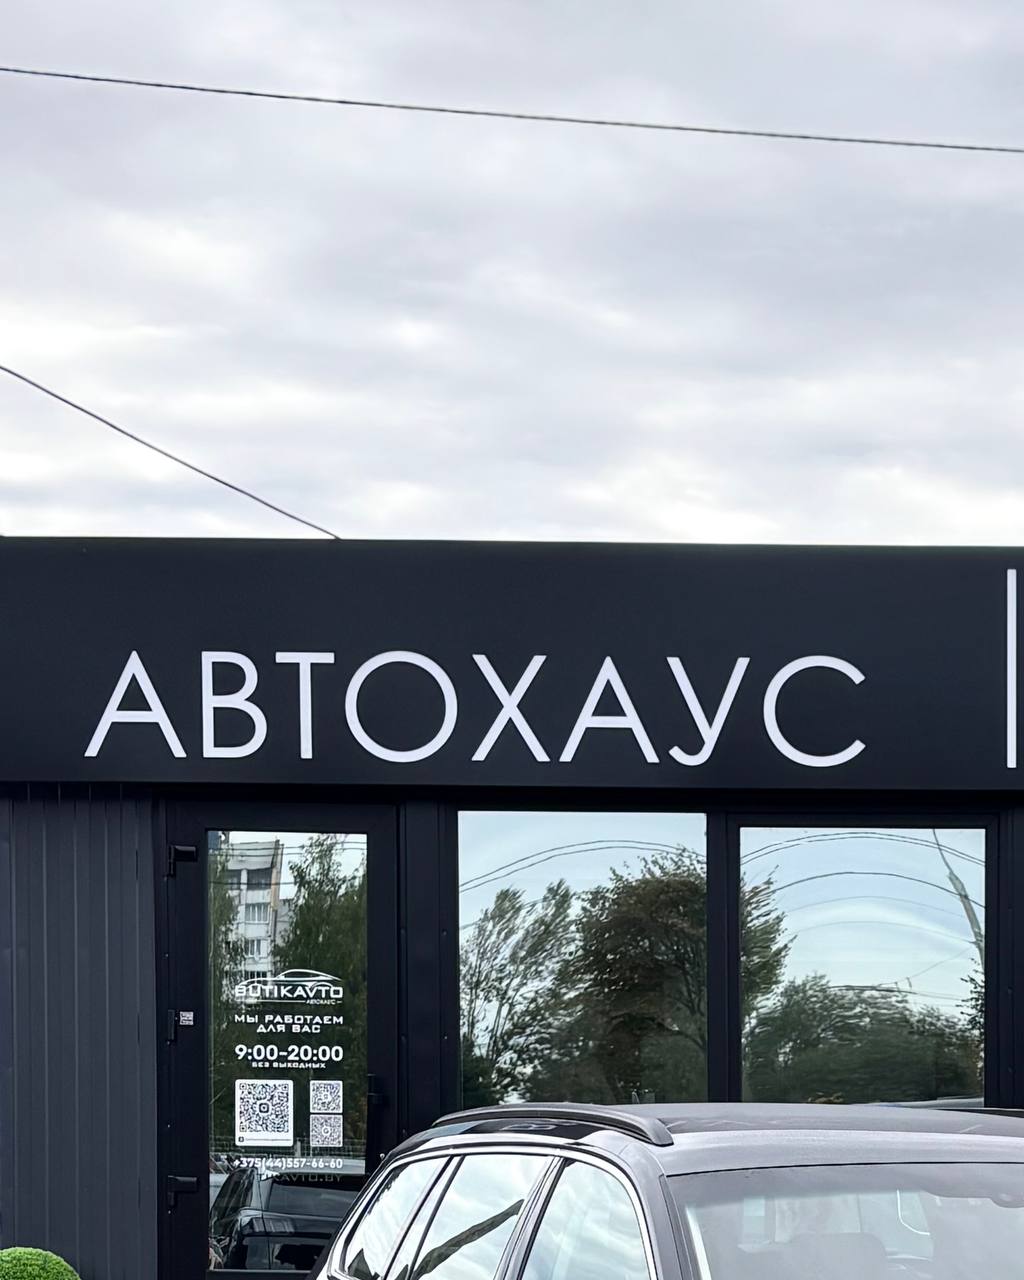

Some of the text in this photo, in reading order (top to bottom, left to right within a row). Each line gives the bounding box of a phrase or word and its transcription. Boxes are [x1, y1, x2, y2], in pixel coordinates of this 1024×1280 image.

[85, 650, 867, 768] АВТОХАУС
[234, 984, 343, 999] BUTIKAVTO
[234, 1014, 343, 1024] МЫ РАБОТАЕМ
[256, 1024, 320, 1034] ДЛЯ ВАС
[234, 1044, 343, 1062] 9:00-20:00
[251, 1061, 327, 1069] БЕЗ ВЫХОДНЫХ
[233, 1157, 343, 1170] +375(44)557-66-60
